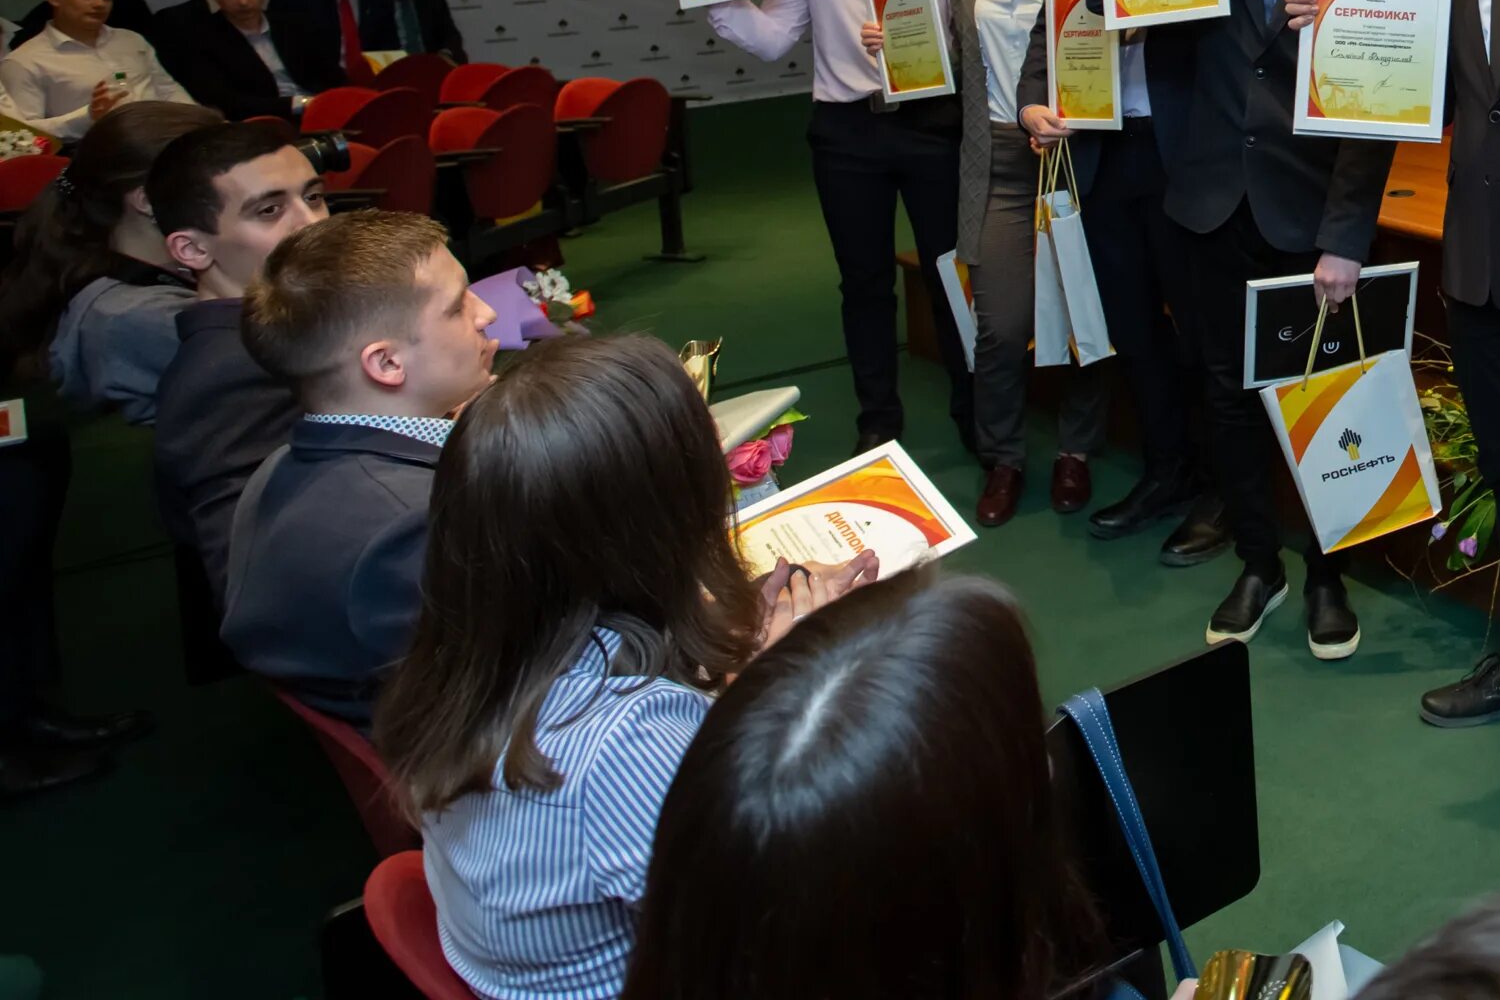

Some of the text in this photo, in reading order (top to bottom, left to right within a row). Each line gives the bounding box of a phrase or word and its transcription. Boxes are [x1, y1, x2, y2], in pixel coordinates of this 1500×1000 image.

[1334, 7, 1416, 21] СЕРТИФИКАТ
[1321, 454, 1396, 482] РОСНЕФТЬ
[824, 511, 865, 554] ДИПЛОМ
